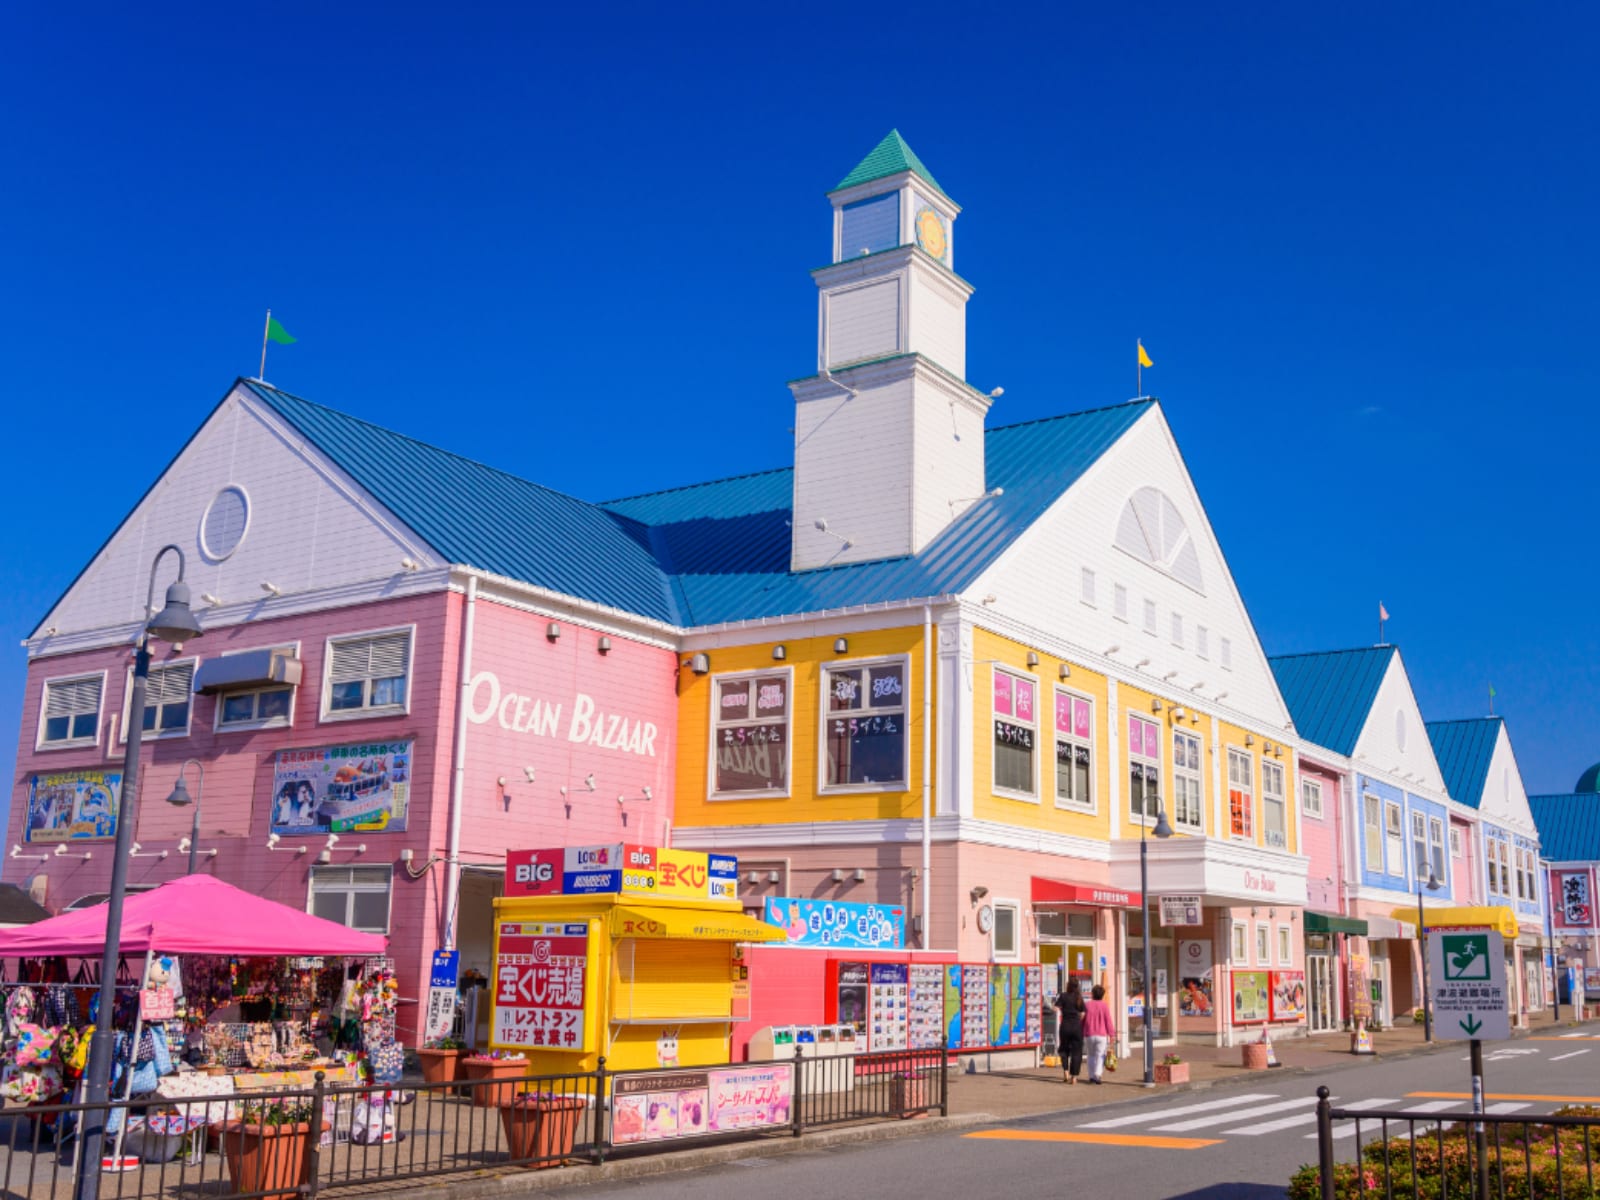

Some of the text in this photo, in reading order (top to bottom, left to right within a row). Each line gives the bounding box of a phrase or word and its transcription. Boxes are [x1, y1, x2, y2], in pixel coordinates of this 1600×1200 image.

[630, 849, 651, 865] BIG
[515, 861, 554, 883] BIG
[659, 861, 706, 889] 宝くじ
[623, 920, 658, 933] 宝くじ
[498, 966, 583, 1007] 宝くじ売場
[515, 1010, 577, 1028] レストラン
[533, 1029, 577, 1047] 営業中
